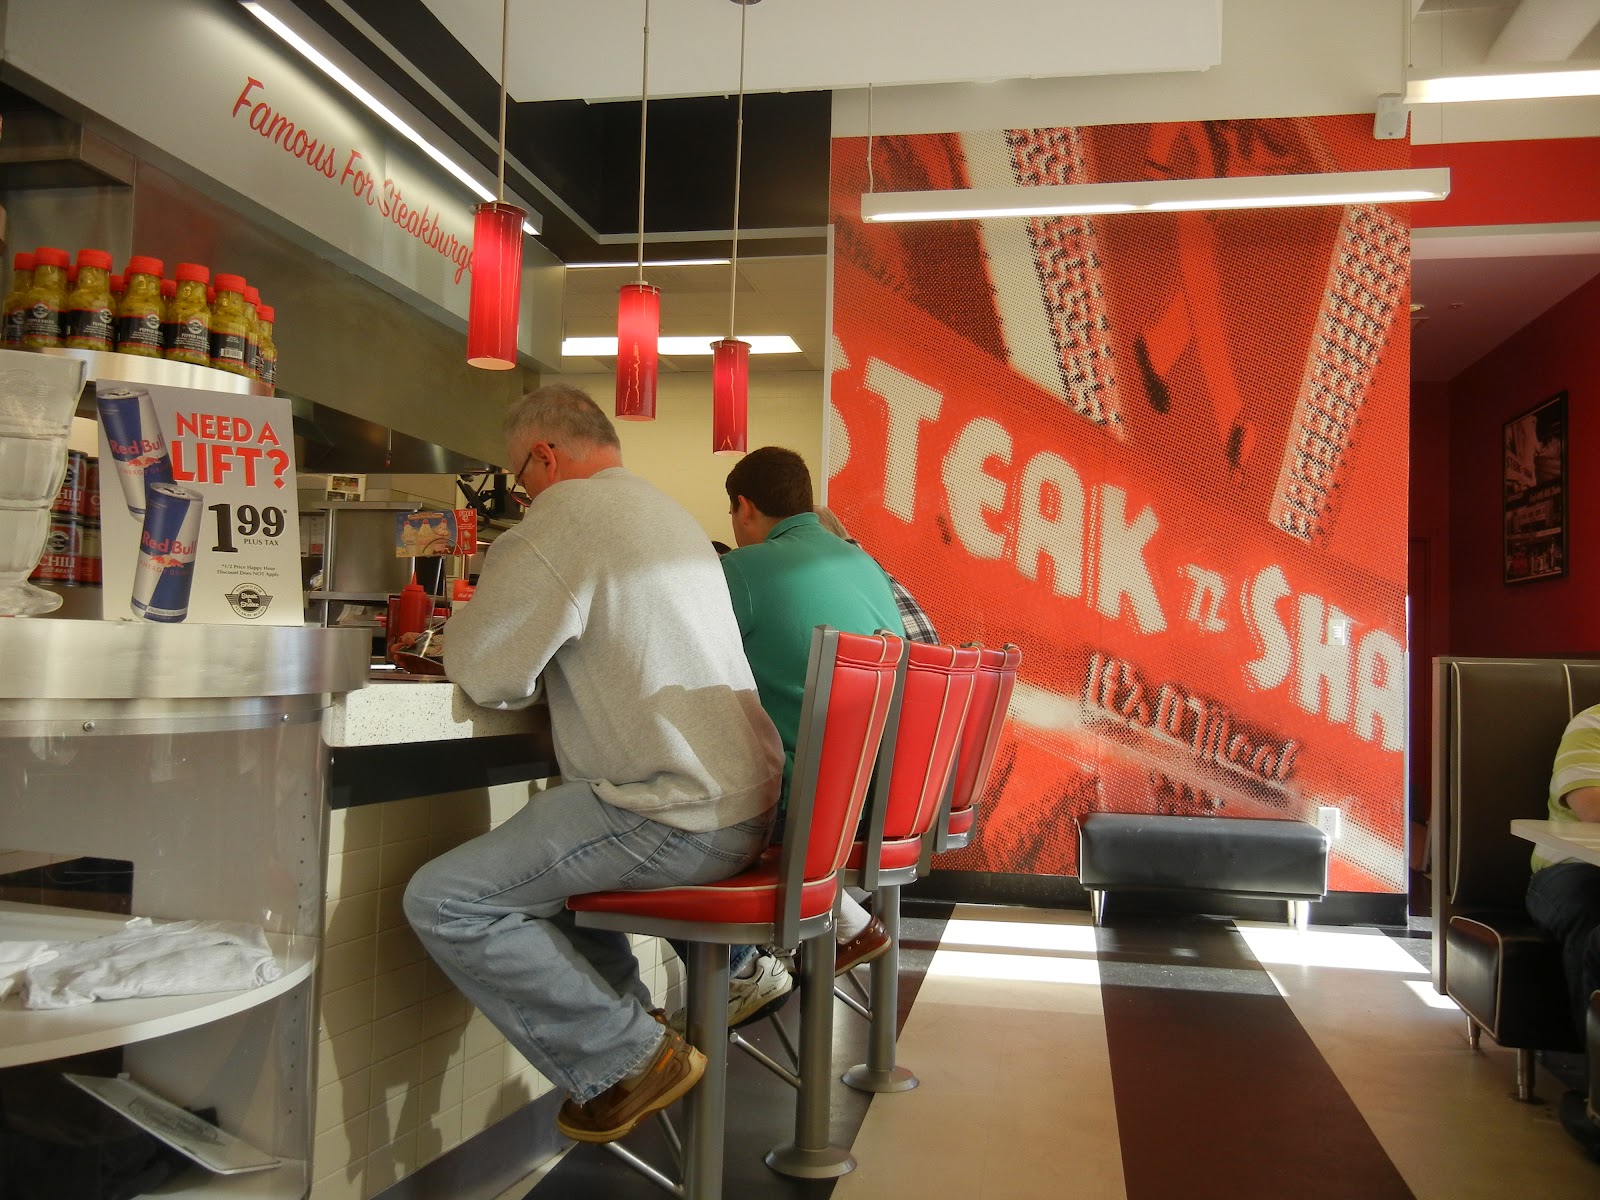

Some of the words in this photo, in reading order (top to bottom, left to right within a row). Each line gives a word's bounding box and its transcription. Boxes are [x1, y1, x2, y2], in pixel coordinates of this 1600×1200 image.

[233, 77, 336, 178] Famous
[341, 149, 375, 205] For
[176, 411, 254, 443] NEED
[257, 421, 281, 446] A
[109, 440, 139, 455] Red
[141, 433, 165, 453] Bull
[171, 440, 291, 489] LIFT?
[58, 488, 81, 501] HILI
[141, 530, 169, 553] Red
[171, 540, 198, 555] Bull
[39, 555, 75, 568] CHILI
[1241, 564, 1404, 752] SHA
